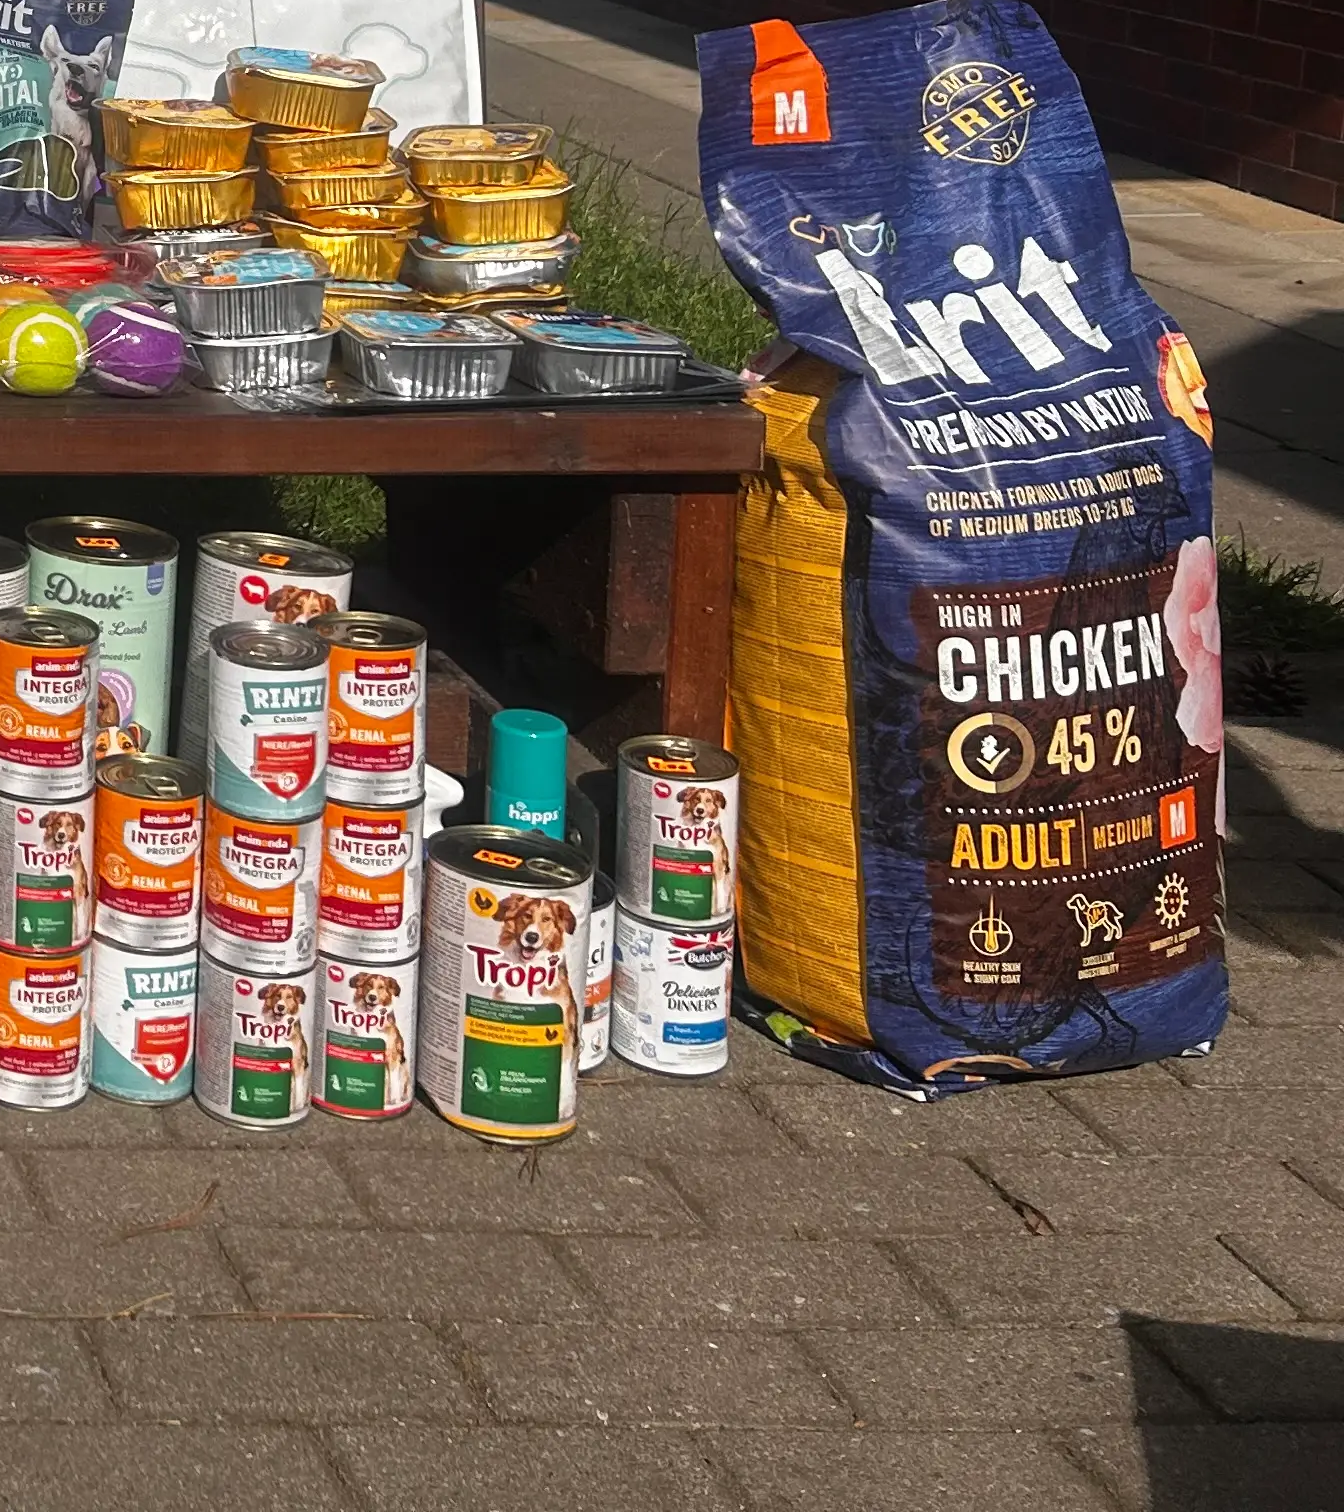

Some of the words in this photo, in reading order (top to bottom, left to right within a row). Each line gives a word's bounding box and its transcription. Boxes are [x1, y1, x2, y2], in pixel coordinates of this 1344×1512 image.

[67, 2, 106, 14] FREE
[929, 68, 983, 106] GMO
[774, 92, 808, 134] M
[923, 80, 1035, 156] FREE
[991, 135, 1021, 161] SOY
[927, 487, 1004, 511] CHICKEN
[1007, 480, 1069, 506] FORMULA
[1070, 477, 1098, 497] FOR
[1098, 468, 1132, 492] ADULT
[1133, 464, 1164, 485] DOGS
[929, 520, 952, 537] OF
[960, 513, 1029, 537] MEDIUM
[1033, 509, 1084, 531] BREEDS
[1086, 503, 1118, 524] 10-25
[1120, 499, 1135, 516] KG
[938, 605, 991, 627] HIGH
[1002, 604, 1021, 625] IN
[937, 612, 1165, 702] CHICKEN
[24, 678, 87, 694] INTEGRA
[347, 680, 417, 696] INTEGRA
[252, 687, 324, 710] RINTI
[362, 698, 404, 708] PROTECT
[26, 725, 60, 738] RENAL
[350, 728, 386, 742] RENAL
[509, 802, 559, 825] happs
[131, 830, 199, 845] INTEGRA
[655, 816, 713, 845] Tropi
[951, 819, 1076, 870] ADULT
[1093, 814, 1153, 850] MEDIUM
[1169, 801, 1186, 837] M
[18, 842, 75, 871] Tropi
[146, 846, 187, 856] PROTECT
[334, 841, 408, 856] INTEGRA
[225, 848, 298, 871] INTEGRA
[350, 857, 393, 867] PROTECT
[132, 876, 166, 889] RENAL
[239, 867, 282, 881] PROTECT
[336, 885, 372, 901] RENAL
[467, 945, 560, 996] Tropi
[17, 988, 83, 1004] INTEGRA
[668, 998, 717, 1012] DINNERS
[32, 1004, 73, 1014] PROTECT
[329, 1001, 386, 1032] Tropi
[237, 1013, 293, 1043] Tropi
[19, 1034, 54, 1047] RENAL
